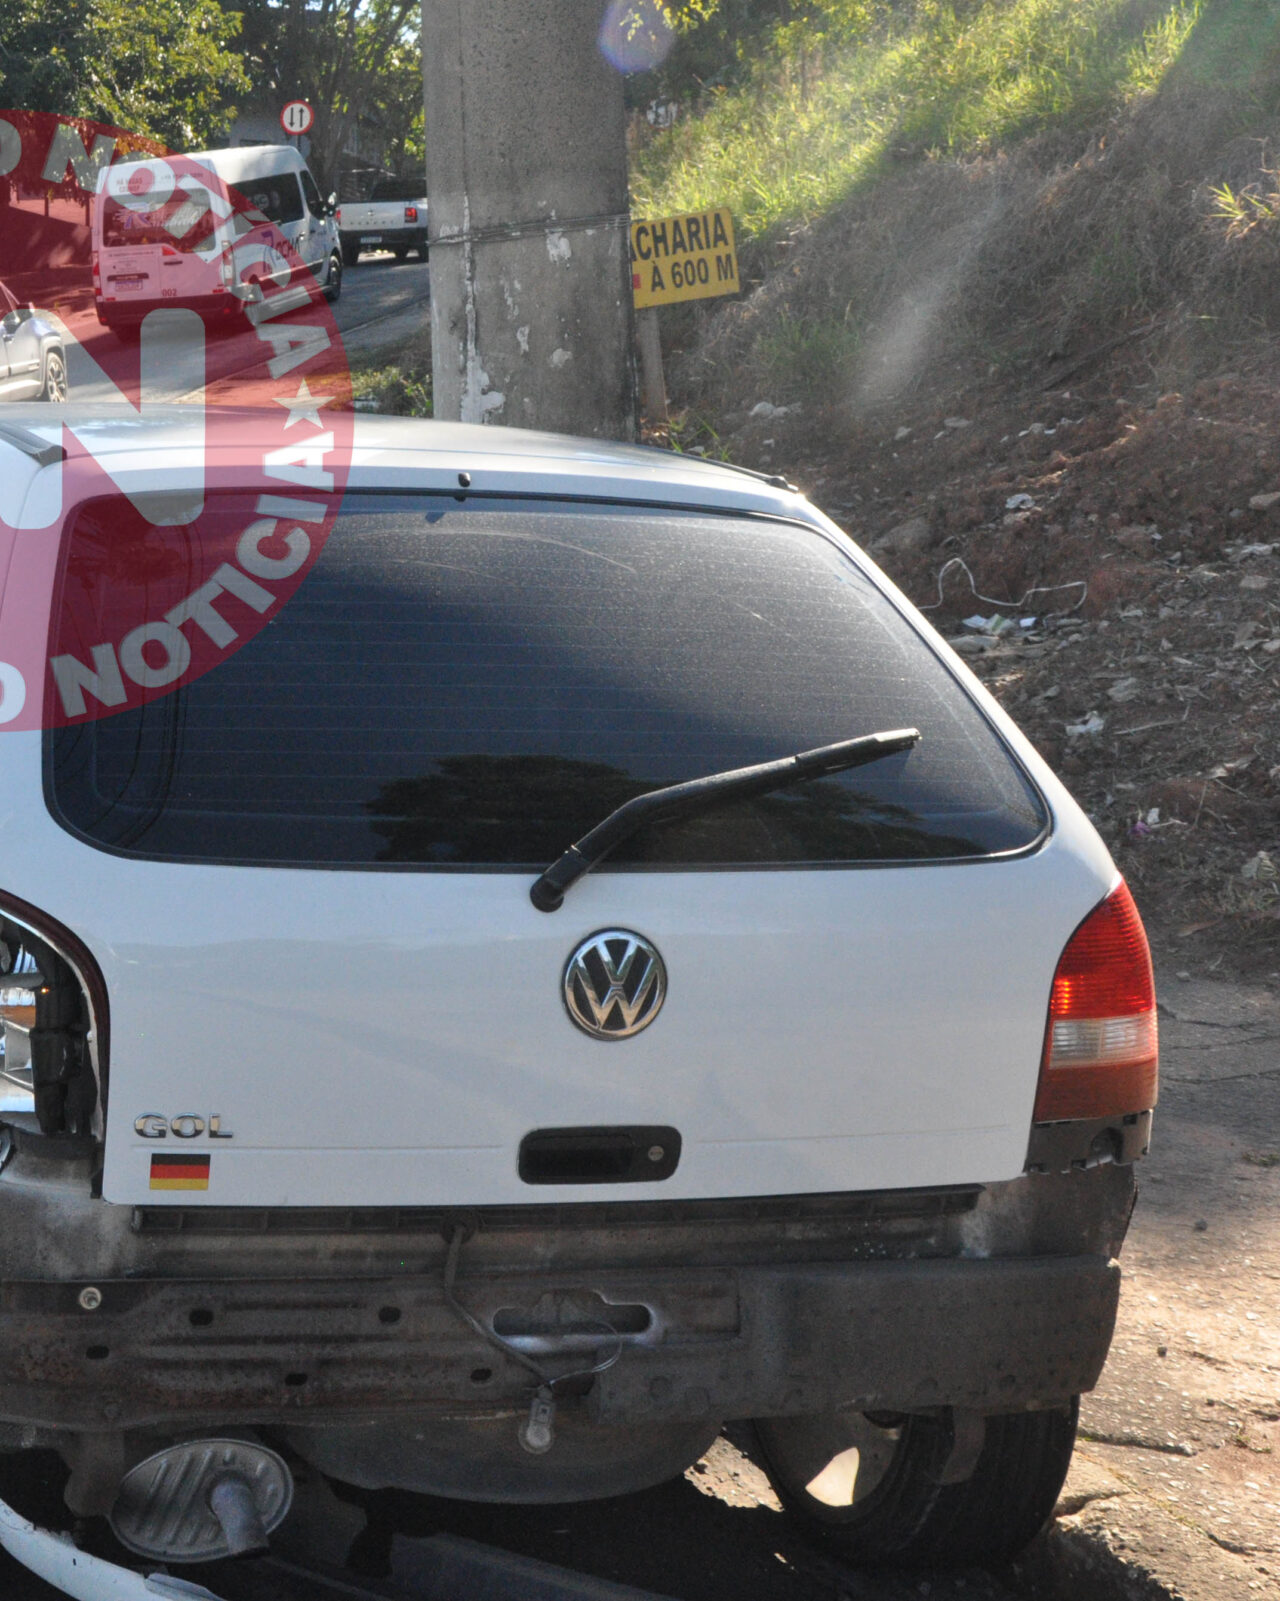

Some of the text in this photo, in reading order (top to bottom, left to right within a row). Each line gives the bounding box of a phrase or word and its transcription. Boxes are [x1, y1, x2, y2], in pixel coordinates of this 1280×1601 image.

[651, 253, 735, 292] À 600 M
[162, 289, 178, 297] 002
[133, 1111, 235, 1139] GOL
